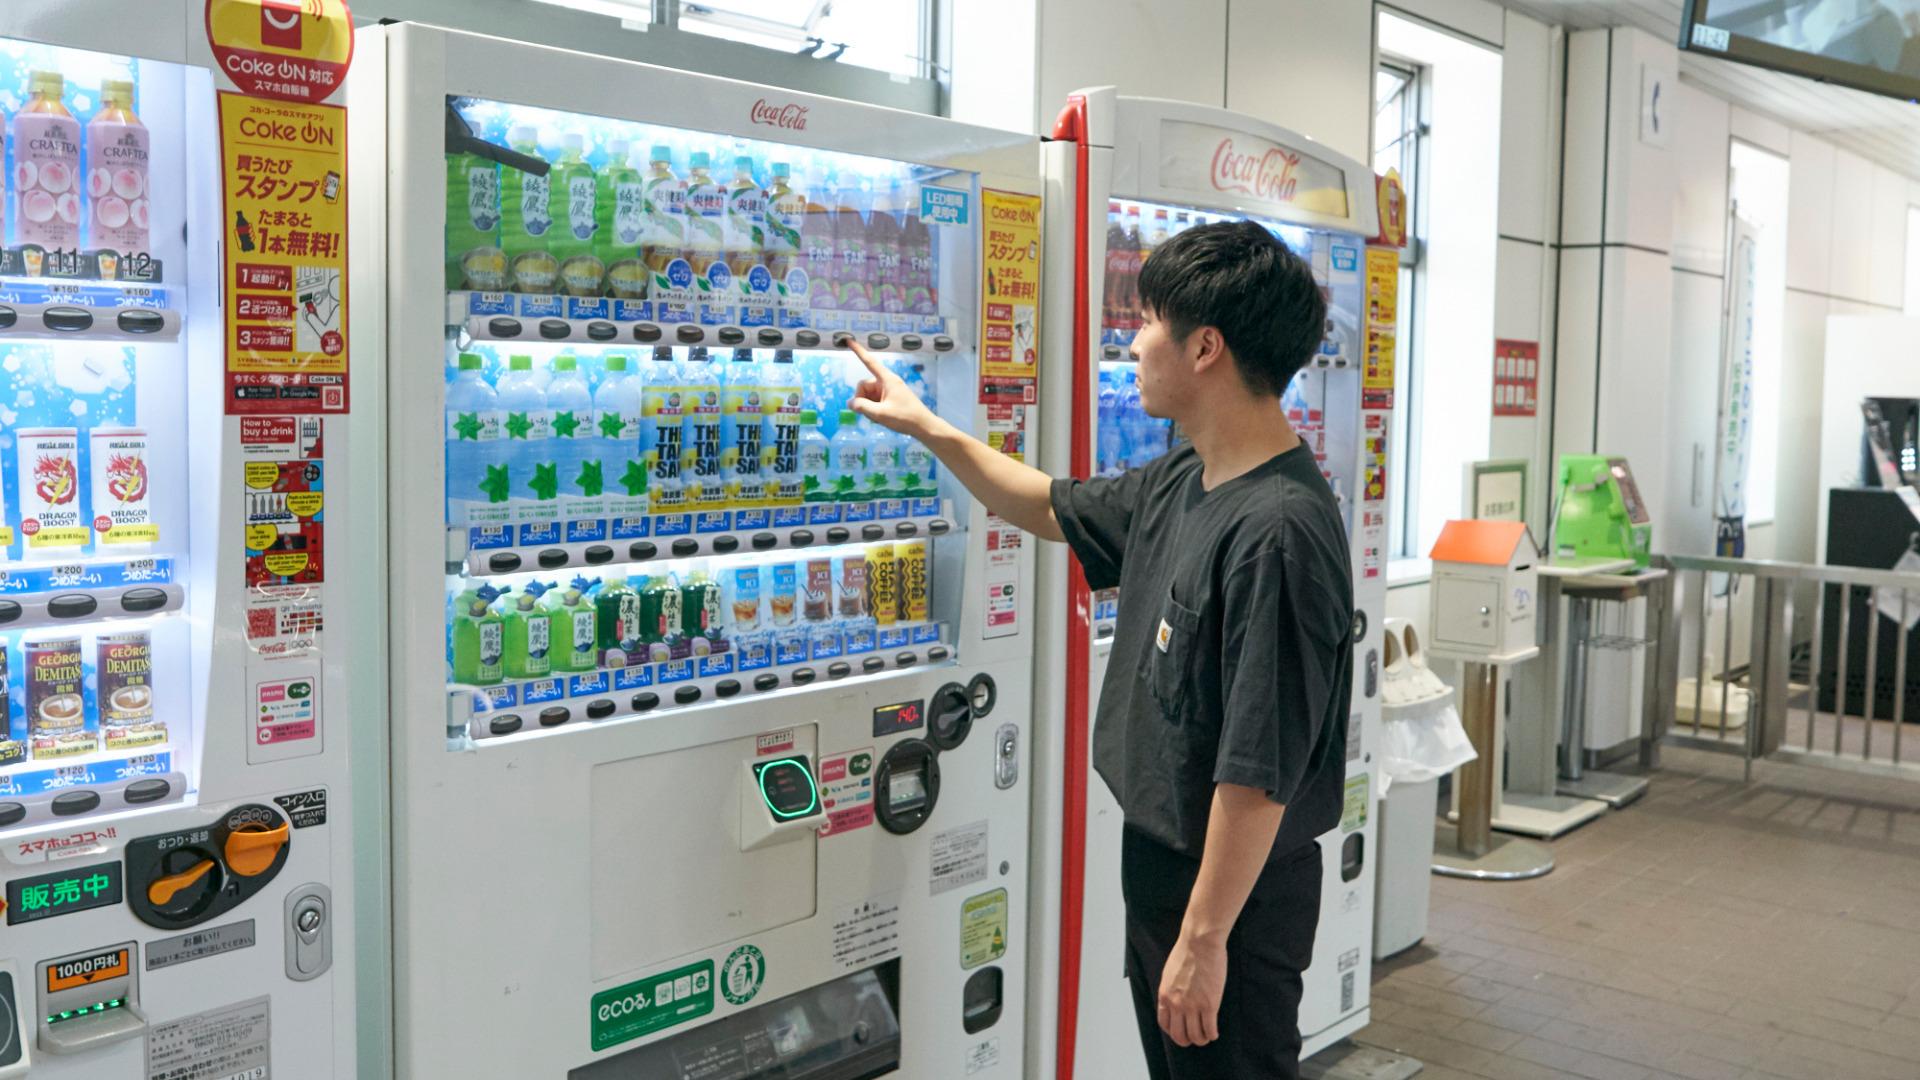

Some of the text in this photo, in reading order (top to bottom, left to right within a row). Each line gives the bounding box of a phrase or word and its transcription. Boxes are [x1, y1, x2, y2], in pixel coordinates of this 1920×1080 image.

[226, 55, 334, 85] Coke ON 対応
[751, 98, 809, 130] Coca-Cola
[239, 117, 334, 146] Coke ON
[30, 139, 77, 155] CRAFTEA
[103, 147, 148, 161] CRAFTEA
[236, 155, 293, 175] 買うたび
[1210, 137, 1300, 201] Coca-Cola
[235, 175, 319, 203] スタンプ
[258, 209, 312, 228] たまると
[53, 247, 151, 277] 11 12
[239, 299, 251, 314] 2
[240, 331, 251, 345] 3
[243, 419, 271, 428] How to
[243, 427, 261, 438] buy
[270, 426, 293, 436] drink
[39, 511, 77, 520] DRAGON
[111, 509, 148, 518] DRAGON
[115, 516, 146, 524] BOOST
[43, 519, 75, 527] BOOST
[281, 790, 325, 807] コイン入口
[21, 873, 110, 912] 販売中
[57, 953, 120, 980] 1000円札
